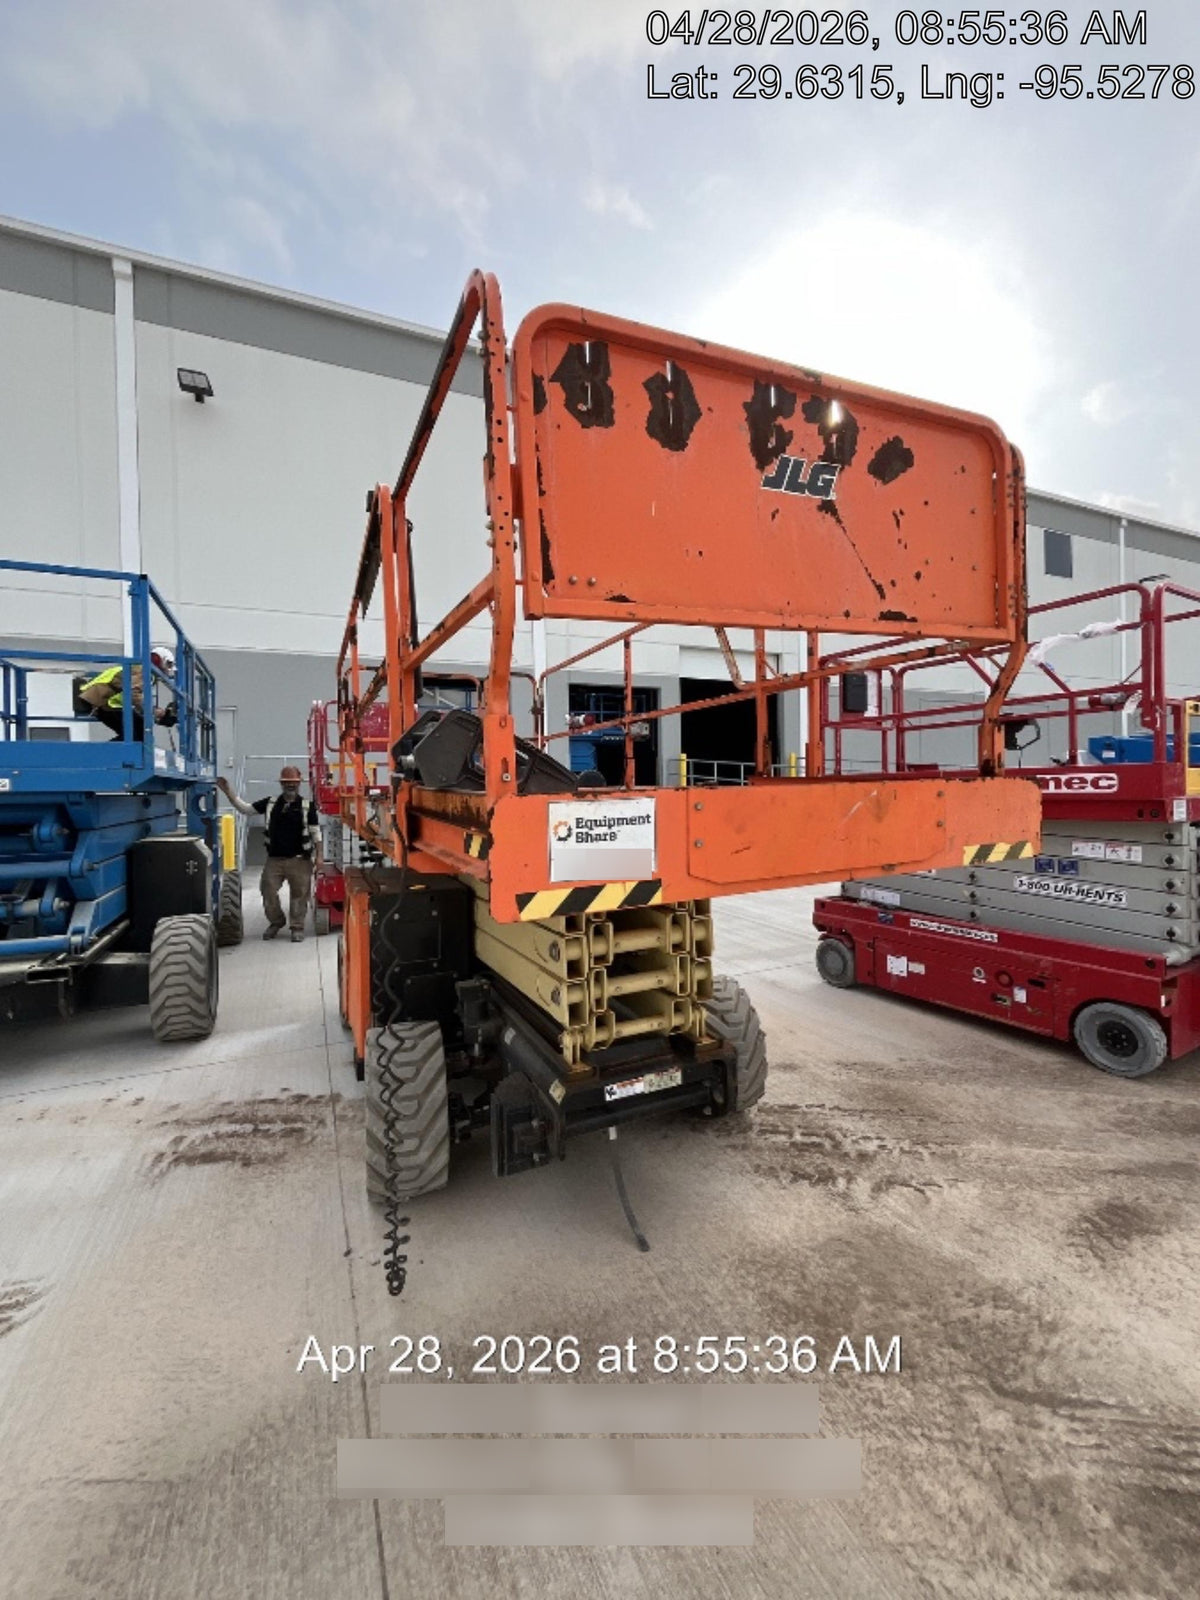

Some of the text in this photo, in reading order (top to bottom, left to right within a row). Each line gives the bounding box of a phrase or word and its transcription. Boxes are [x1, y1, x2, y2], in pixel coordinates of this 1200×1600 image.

[760, 454, 841, 500] JLG
[575, 813, 652, 830] Equipment
[575, 830, 618, 843] Share
